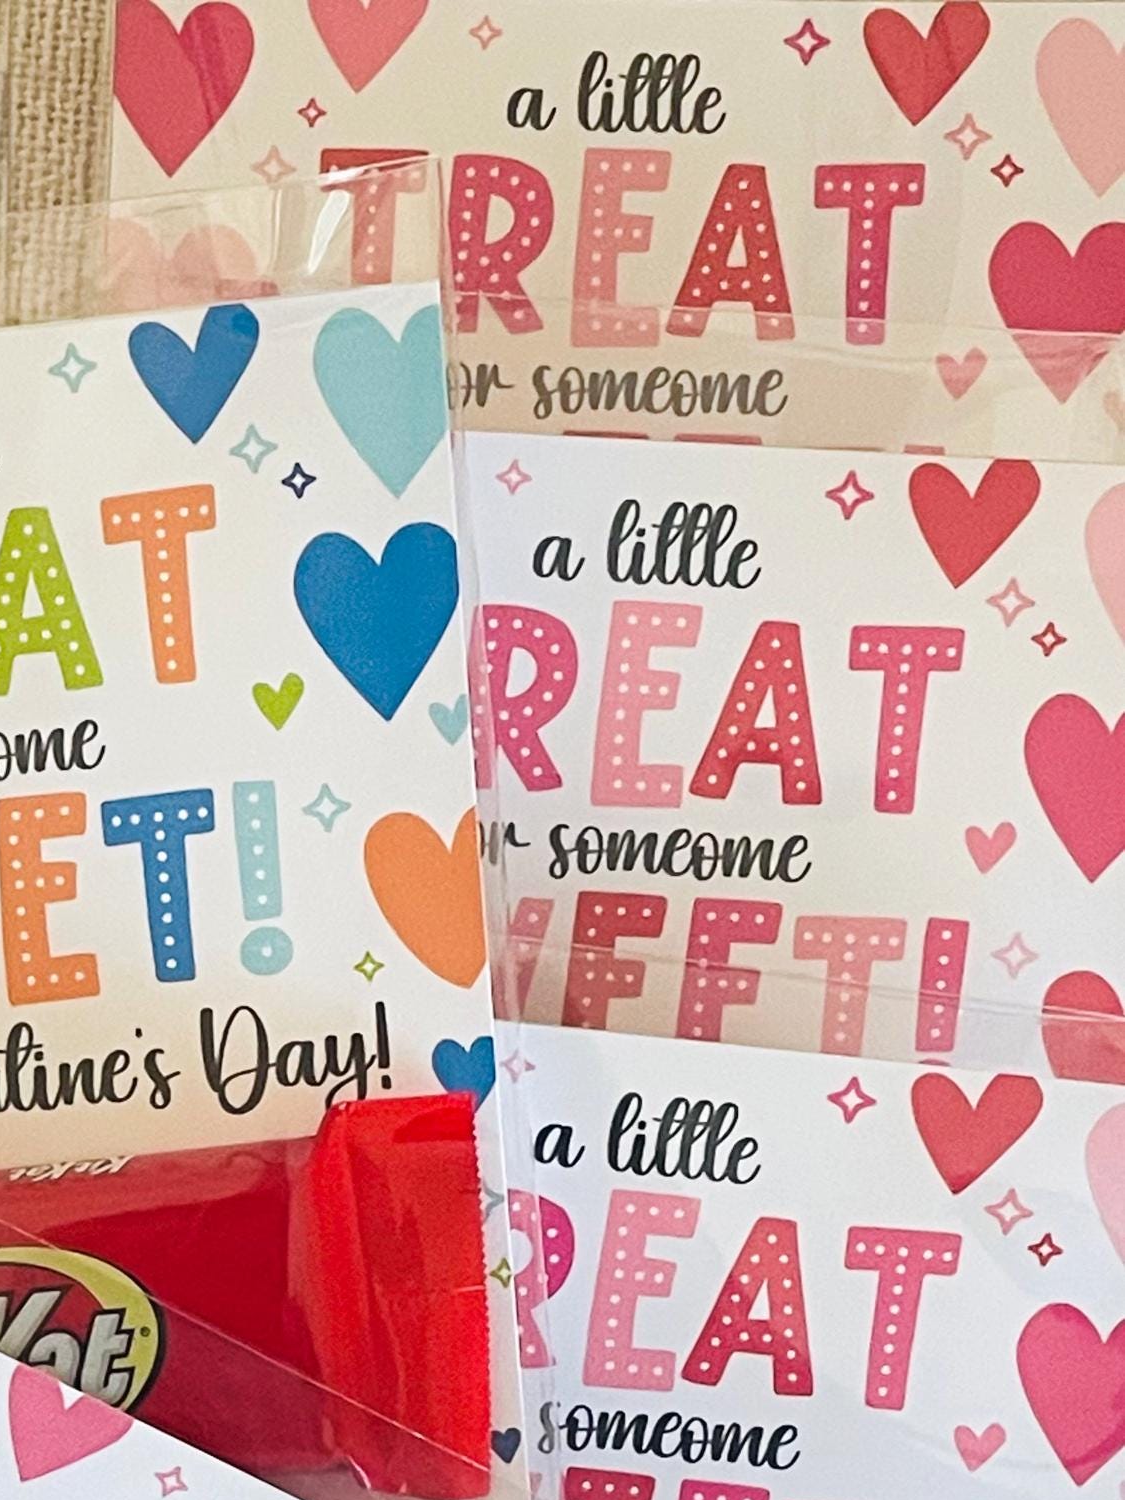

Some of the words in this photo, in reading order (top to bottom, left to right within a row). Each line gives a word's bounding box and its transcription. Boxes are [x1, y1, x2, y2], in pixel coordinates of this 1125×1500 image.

[506, 85, 557, 132] a
[577, 51, 727, 135] little
[320, 147, 927, 347] TREAT
[533, 533, 585, 581] a
[606, 498, 762, 590] little
[471, 600, 966, 815] REAT
[199, 1000, 393, 1118] Day!
[534, 1121, 585, 1169] a
[607, 1091, 762, 1185] little
